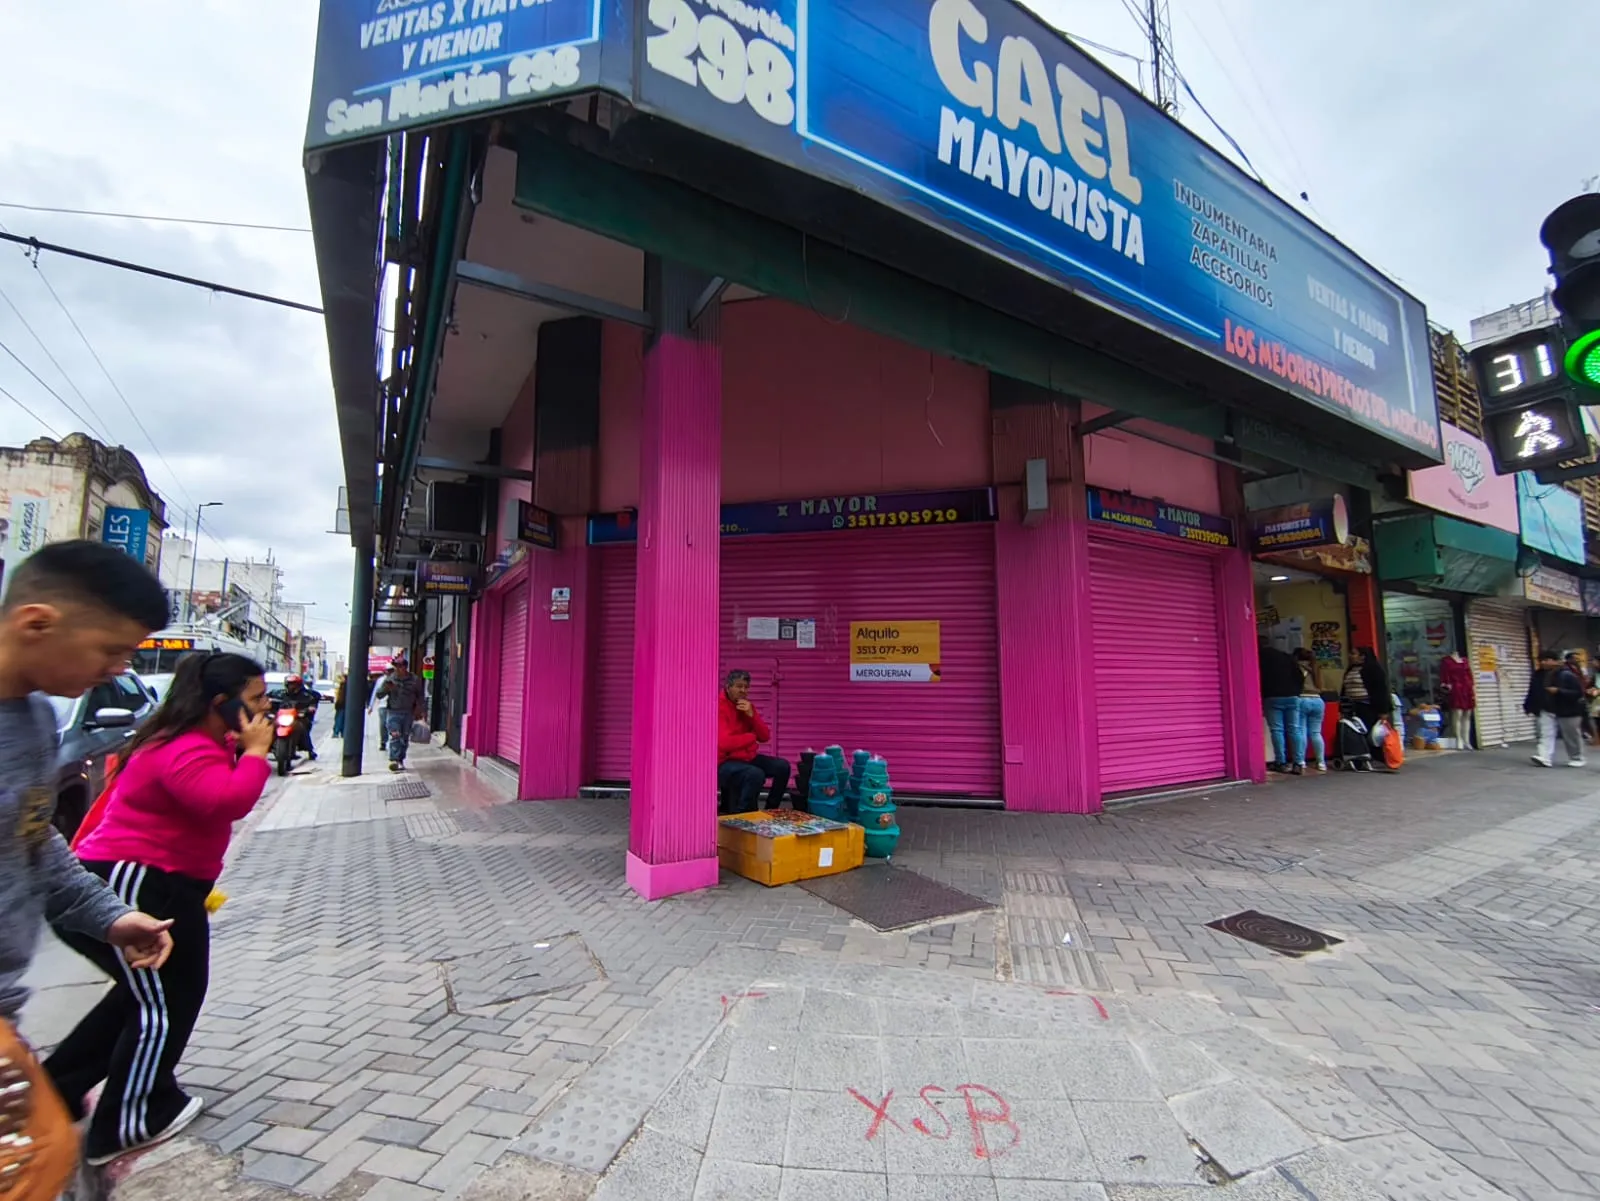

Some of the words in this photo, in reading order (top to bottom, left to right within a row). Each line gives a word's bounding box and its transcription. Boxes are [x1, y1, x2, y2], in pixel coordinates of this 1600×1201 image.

[361, 1, 446, 49] VENTAS
[402, 41, 417, 71] Y
[419, 22, 503, 67] MENOR
[647, 0, 795, 126] 298
[325, 97, 383, 136] San
[507, 45, 581, 97] 298
[929, 0, 1142, 205] GAEL
[937, 105, 1145, 266] MAYORISTA
[1173, 178, 1278, 264] INDUMENTARIA
[1191, 218, 1269, 282] ZAPATILLAS
[1190, 246, 1275, 309] ACCESORIOS
[1224, 318, 1256, 364] LOS
[1258, 337, 1321, 396] MEJORES
[1322, 366, 1371, 419] PRECIOS
[1492, 343, 1553, 393] 31
[800, 496, 877, 516] MAYOR
[848, 509, 957, 528] 3517395920
[1167, 506, 1200, 527] MAYOR
[856, 627, 900, 642] Alquilo
[856, 645, 877, 655] 3513
[879, 645, 919, 655] 077-390
[856, 669, 913, 678] MERGUERIAN
